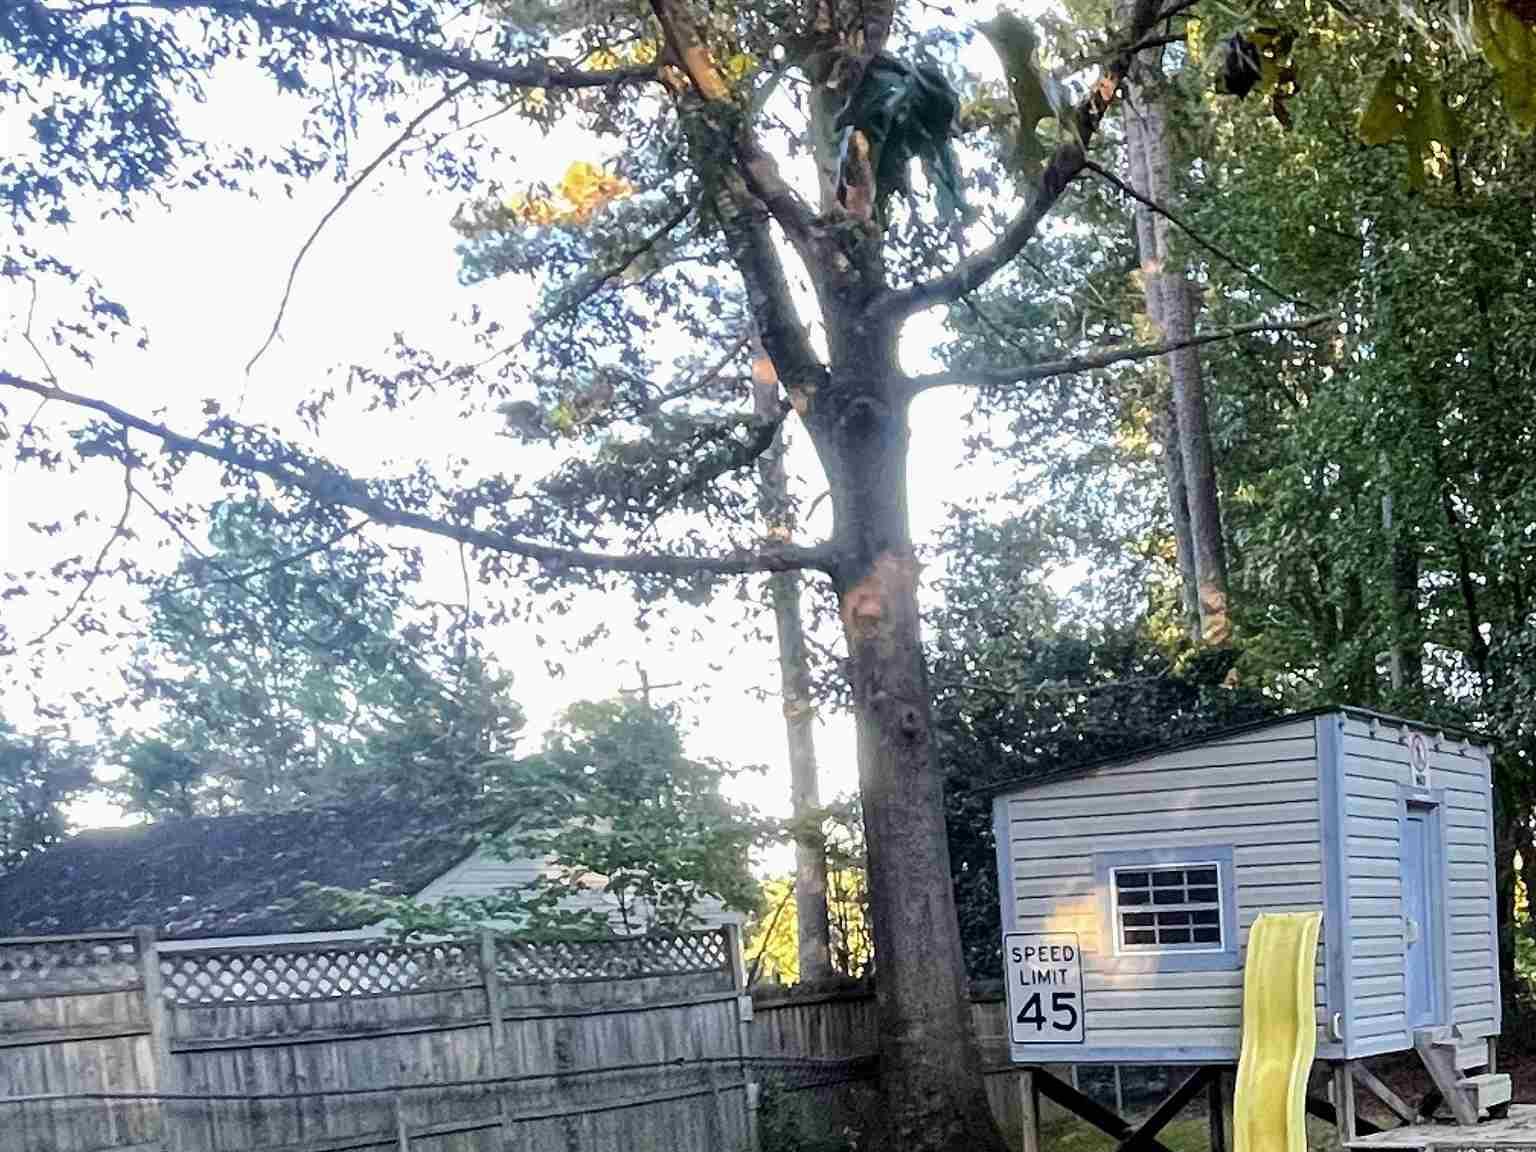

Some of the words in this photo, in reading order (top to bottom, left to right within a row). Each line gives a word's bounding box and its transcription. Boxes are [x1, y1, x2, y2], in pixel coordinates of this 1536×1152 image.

[1012, 946, 1074, 963] SPEED
[1020, 969, 1067, 985] LIMIT
[1016, 992, 1077, 1031] 45
